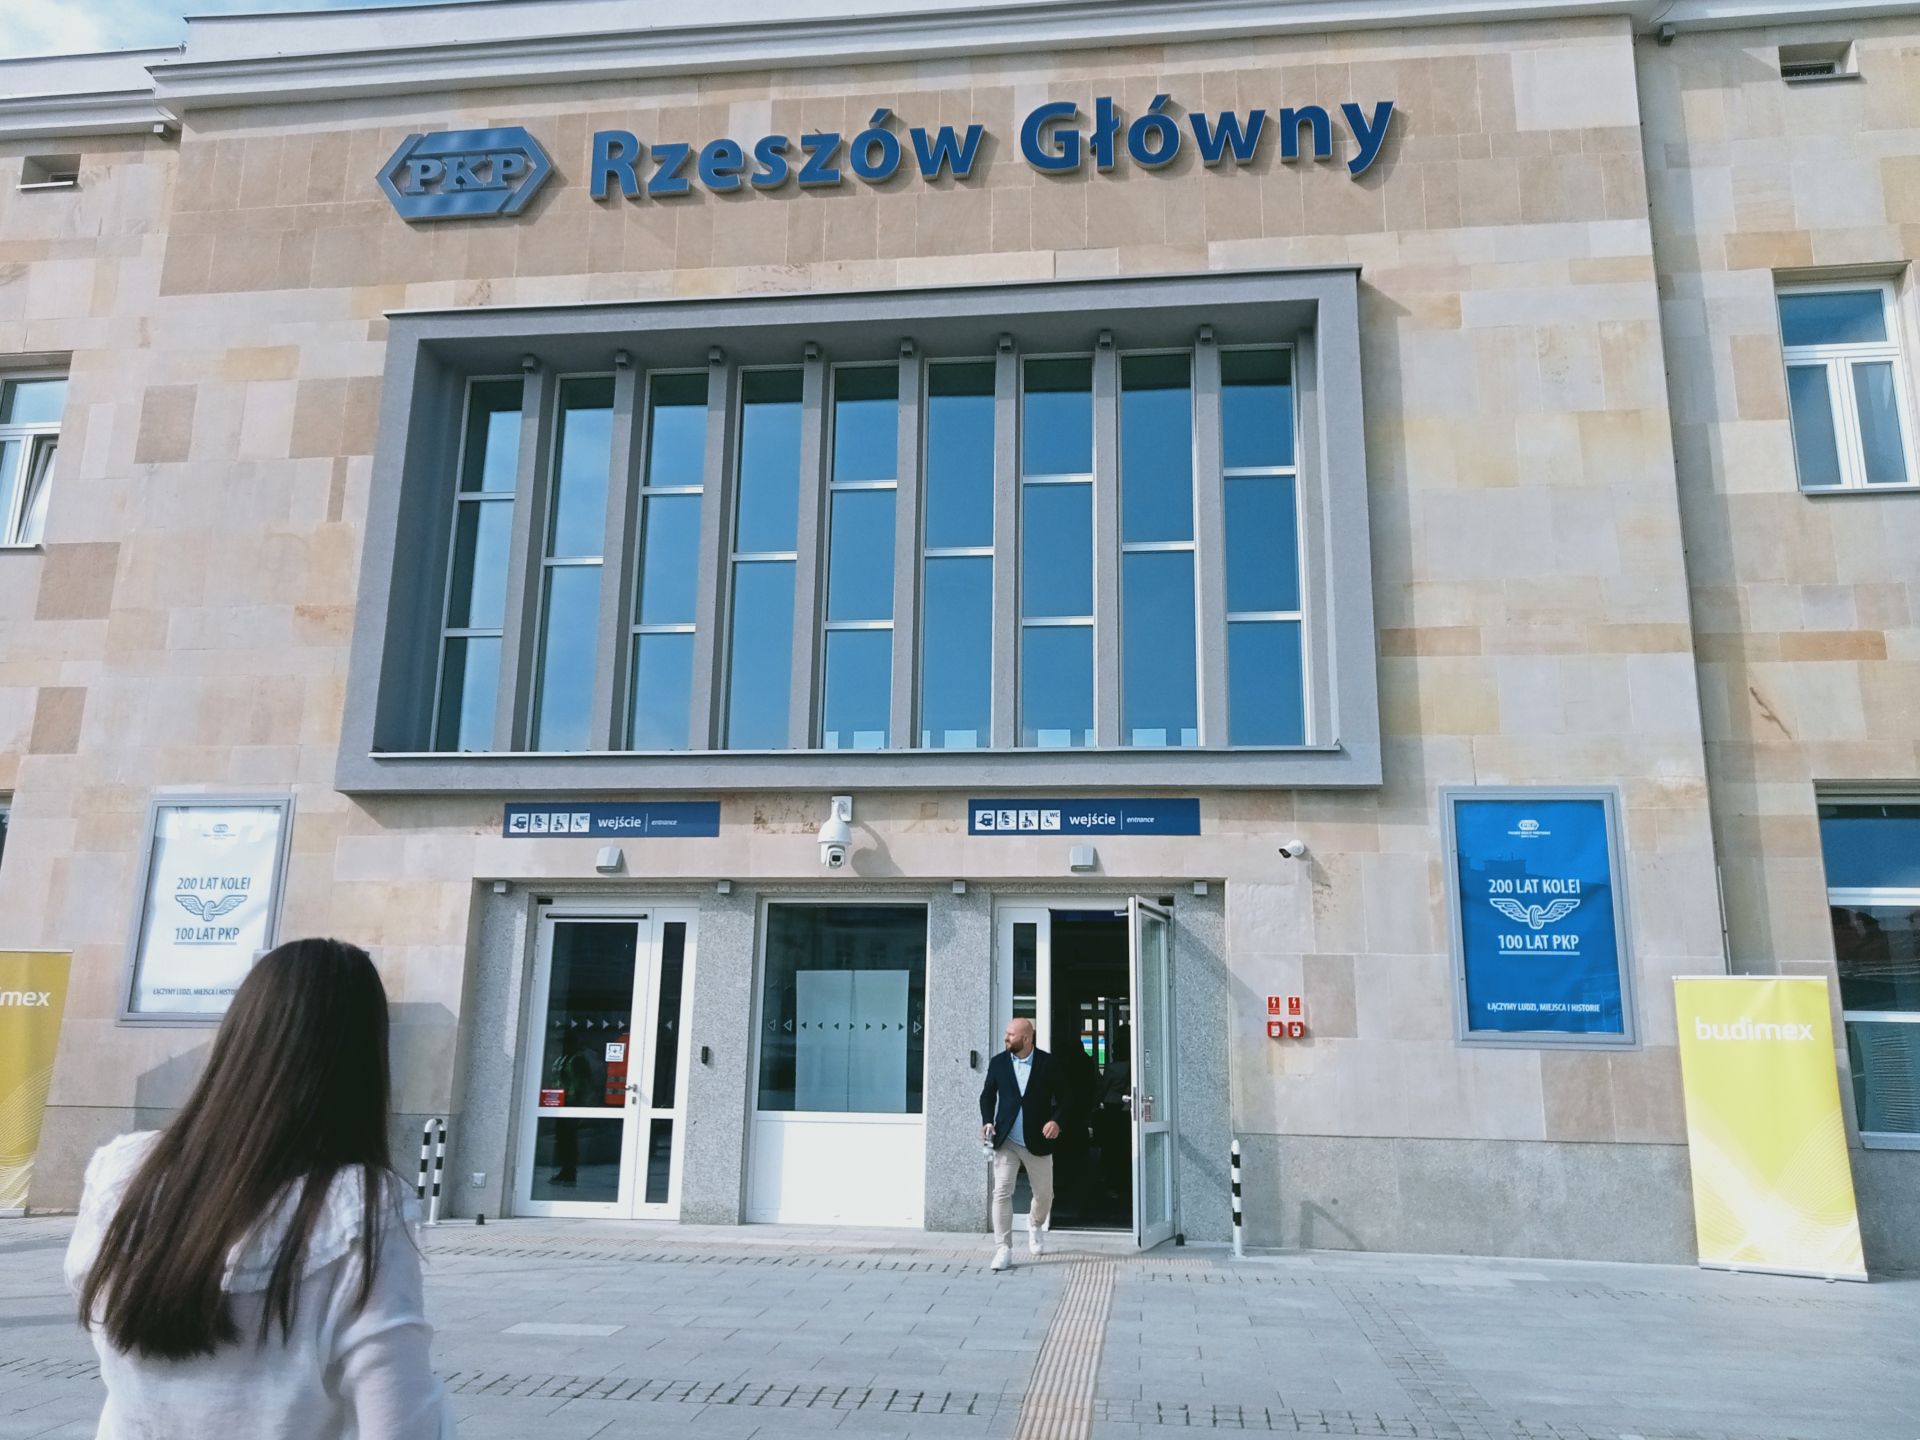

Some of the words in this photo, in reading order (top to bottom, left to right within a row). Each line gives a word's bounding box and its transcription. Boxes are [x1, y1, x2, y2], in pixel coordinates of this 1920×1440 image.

[590, 107, 984, 201] Rzeszów
[1020, 95, 1395, 181] Główny
[404, 153, 529, 195] PKP
[597, 815, 642, 830] wejście
[1069, 812, 1116, 828] wejście
[176, 877, 198, 890] 200
[199, 877, 219, 890] LAT
[220, 877, 251, 890] KOLEI
[1488, 879, 1514, 893] 200
[1515, 879, 1539, 894] LAT
[1542, 879, 1581, 894] KOLEI
[175, 927, 194, 940] 100
[196, 927, 216, 940] LAT
[218, 927, 240, 940] PKP
[1498, 935, 1523, 949] 100
[1525, 935, 1549, 950] LAT
[1552, 935, 1579, 950] PKP
[0, 986, 51, 1006] mex
[1695, 1016, 1814, 1041] budimex
